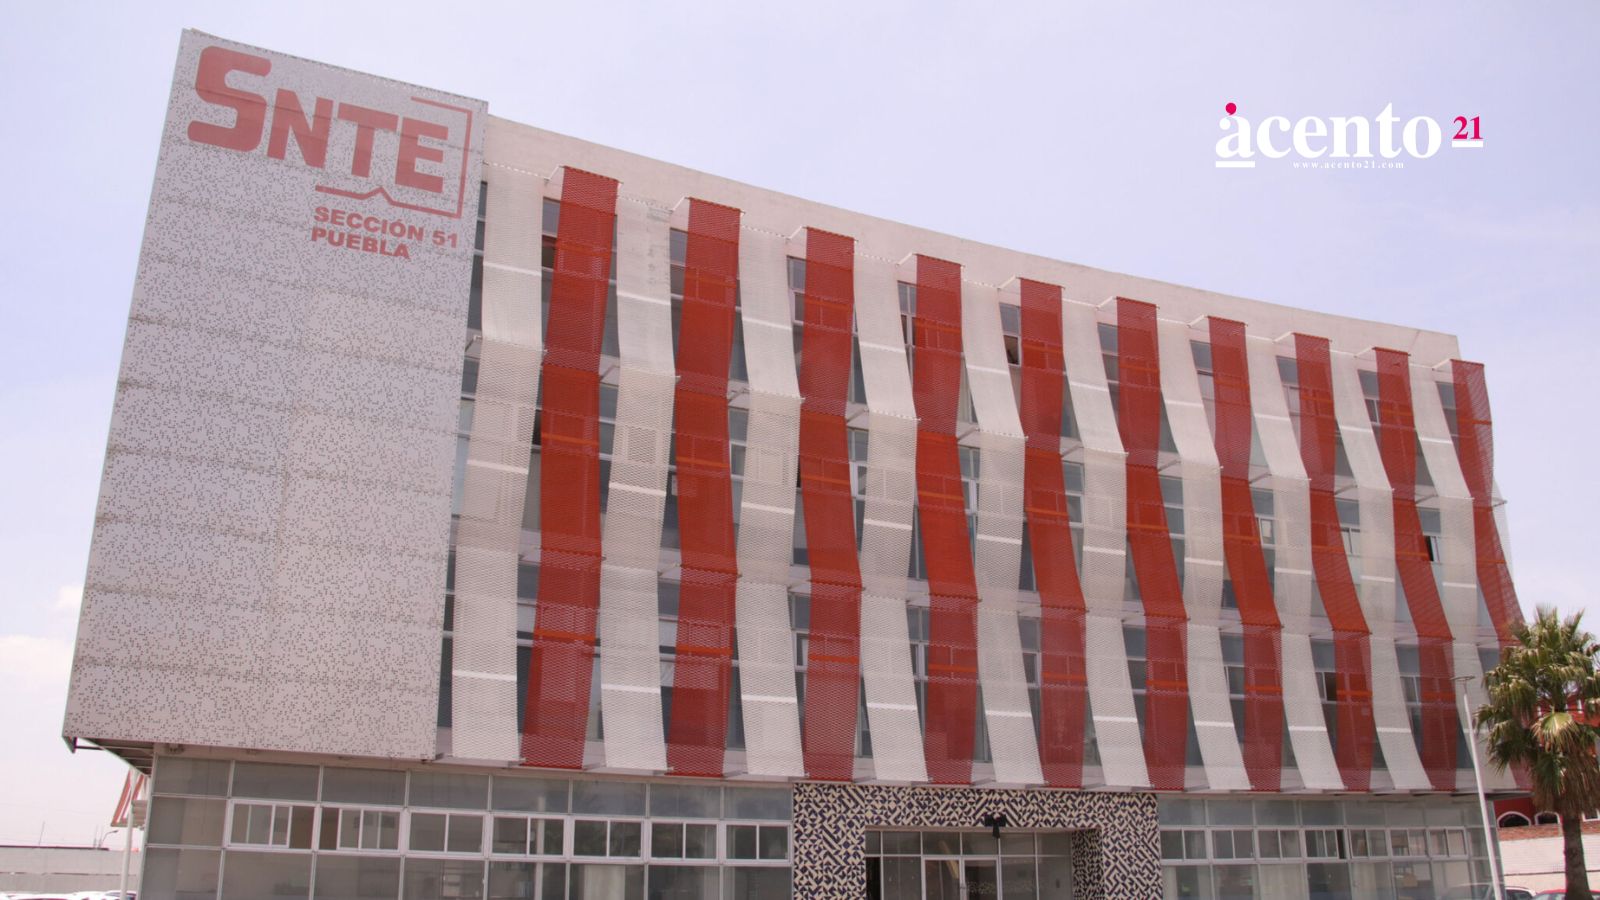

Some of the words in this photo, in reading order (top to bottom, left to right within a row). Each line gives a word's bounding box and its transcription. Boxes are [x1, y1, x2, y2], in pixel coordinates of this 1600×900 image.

[187, 45, 449, 193] SNTE
[311, 227, 411, 259] PUEBLA
[313, 206, 424, 242] SECCIÓN
[432, 229, 458, 249] 51
